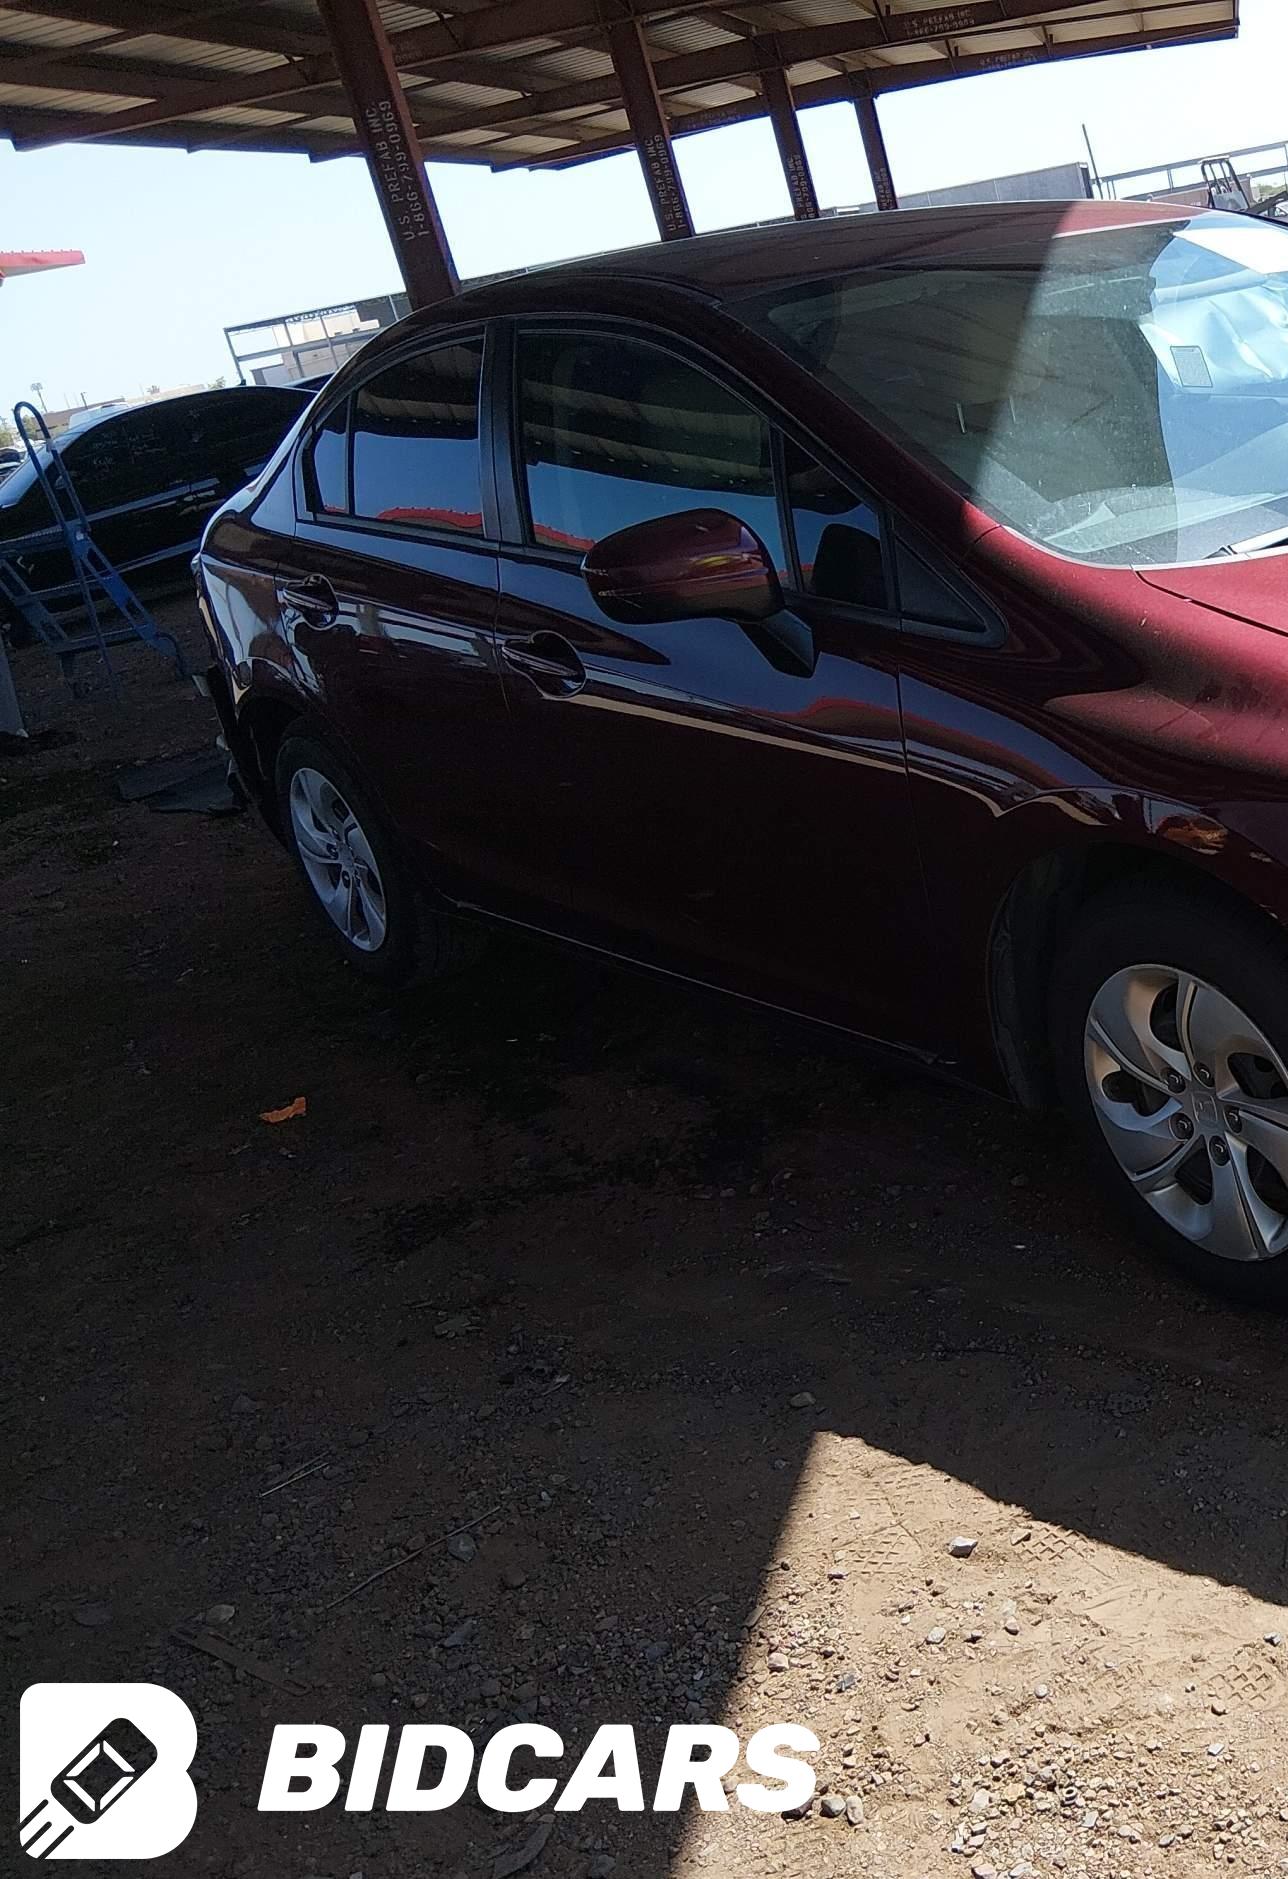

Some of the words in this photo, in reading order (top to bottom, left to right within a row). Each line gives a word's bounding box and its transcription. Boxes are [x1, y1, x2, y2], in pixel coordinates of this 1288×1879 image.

[376, 142, 404, 202] PREFAB
[379, 101, 430, 236] 1-866-799-0969
[651, 161, 670, 205] PREFAB
[399, 210, 416, 240] U.S.
[664, 209, 677, 231] U.S.
